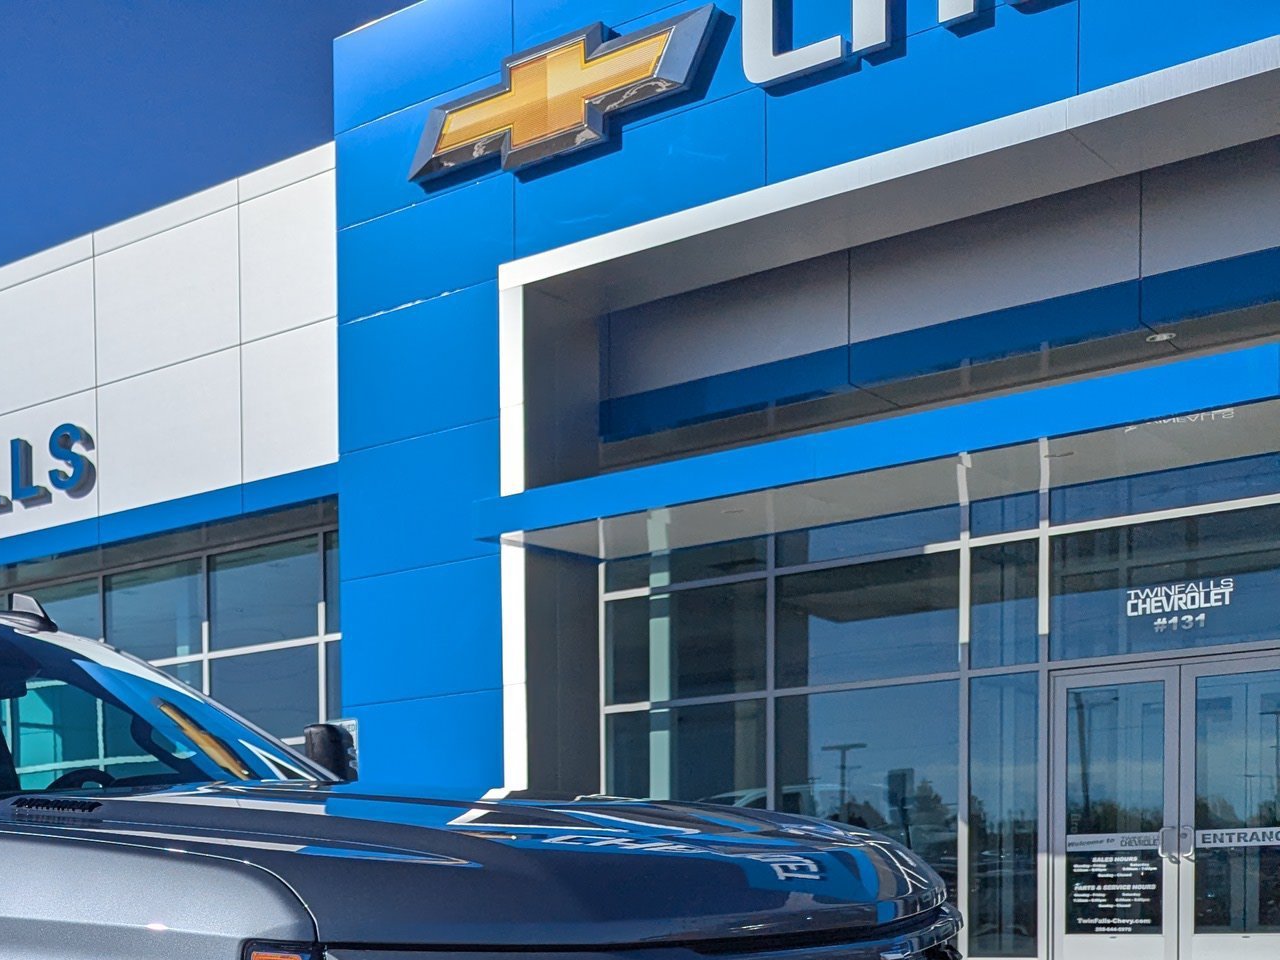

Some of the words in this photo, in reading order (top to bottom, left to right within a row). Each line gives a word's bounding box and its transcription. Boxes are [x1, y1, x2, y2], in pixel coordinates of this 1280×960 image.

[1127, 578, 1234, 600] TWINFALLS
[1127, 588, 1234, 617] CHEVROLET
[1153, 612, 1206, 633] #131
